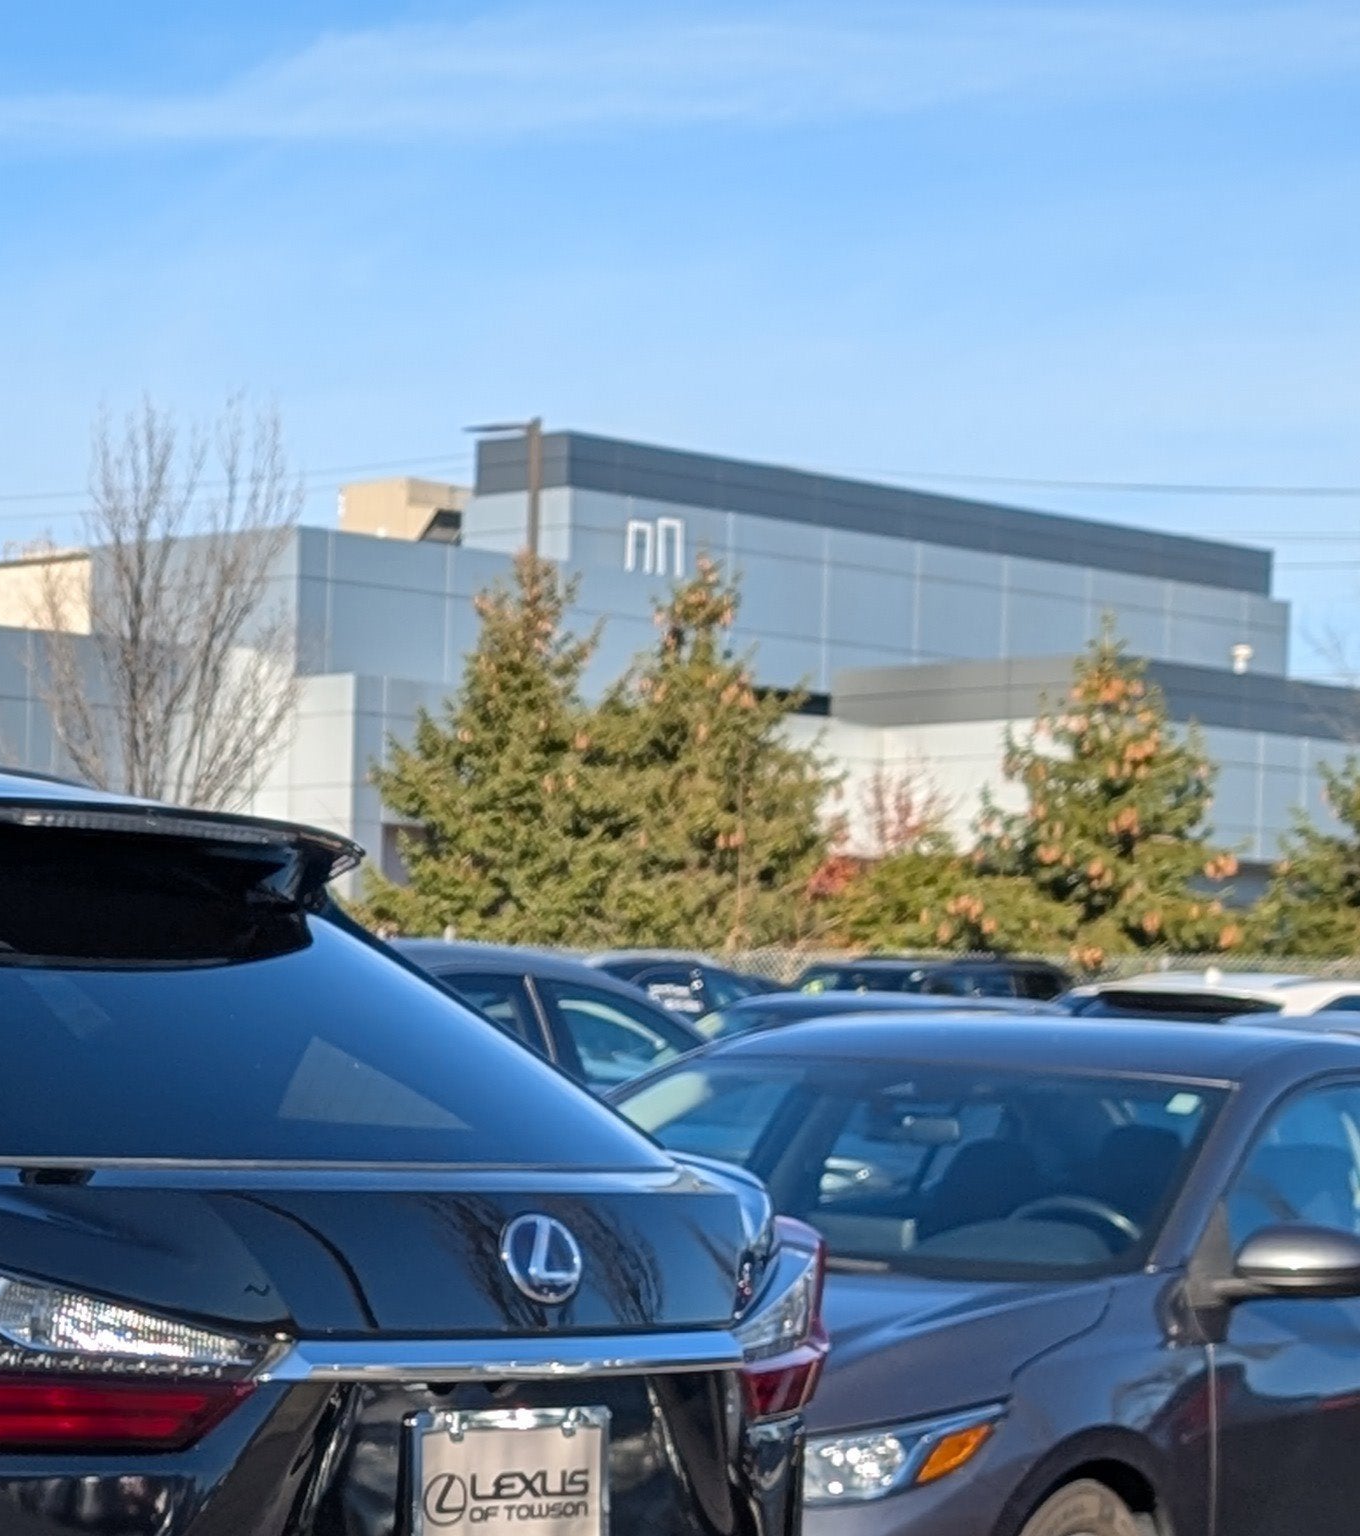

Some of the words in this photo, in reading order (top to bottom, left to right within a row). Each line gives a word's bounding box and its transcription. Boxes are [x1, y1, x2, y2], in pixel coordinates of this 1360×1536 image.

[470, 1468, 590, 1501] LEXUS
[468, 1505, 500, 1524] OF
[503, 1500, 590, 1522] TOWSON
